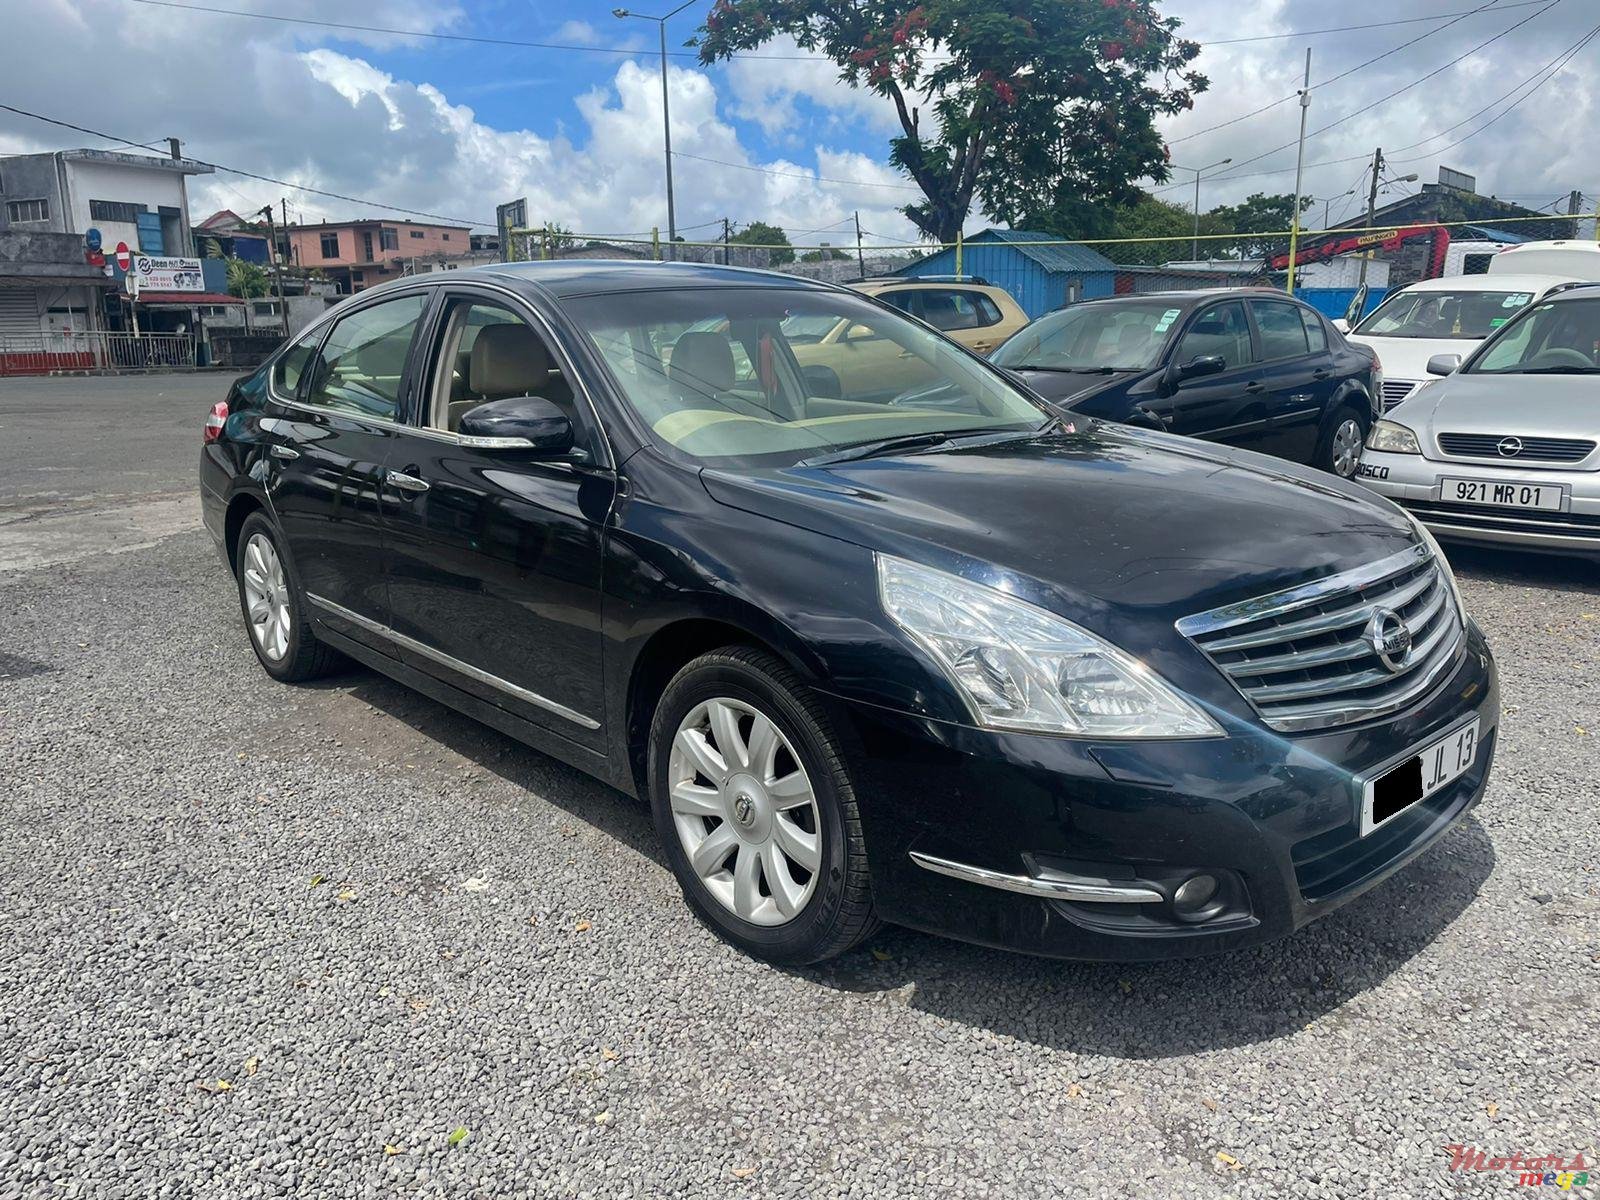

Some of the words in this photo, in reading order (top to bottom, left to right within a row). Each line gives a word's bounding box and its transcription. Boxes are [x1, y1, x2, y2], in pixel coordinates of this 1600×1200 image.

[1456, 481, 1486, 501] 921
[1493, 486, 1515, 504] MR
[1519, 487, 1541, 506] 01
[1427, 745, 1447, 790] JL
[1456, 727, 1475, 772] 13
